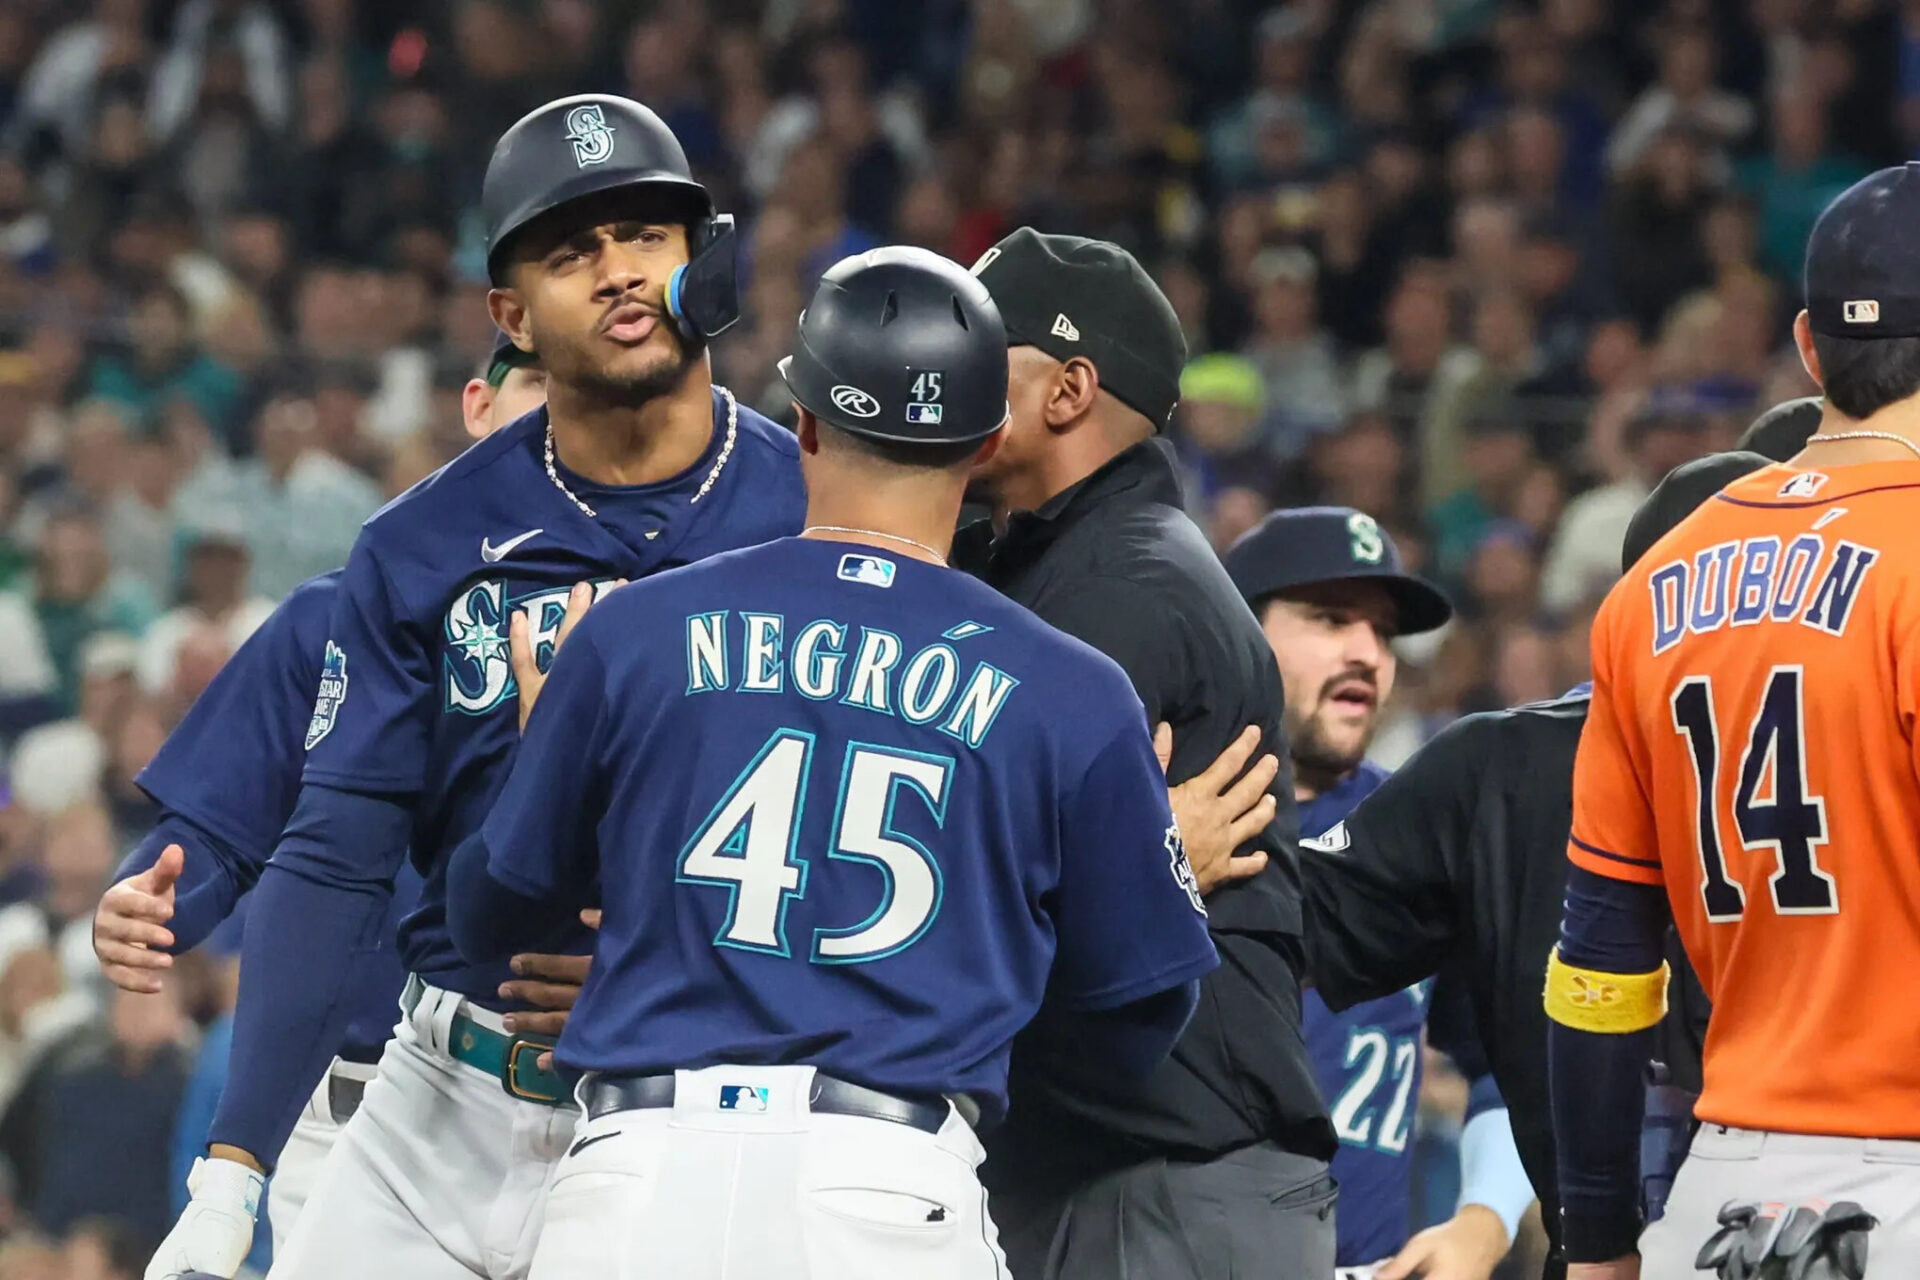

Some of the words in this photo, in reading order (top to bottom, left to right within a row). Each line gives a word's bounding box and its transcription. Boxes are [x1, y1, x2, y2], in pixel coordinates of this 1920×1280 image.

[910, 372, 941, 402] 45
[1649, 507, 1881, 657] DUBÓN
[685, 609, 1021, 749] NEGRÓN
[675, 727, 956, 965] 45
[1669, 664, 1839, 923] 14
[1330, 1025, 1417, 1157] 22
